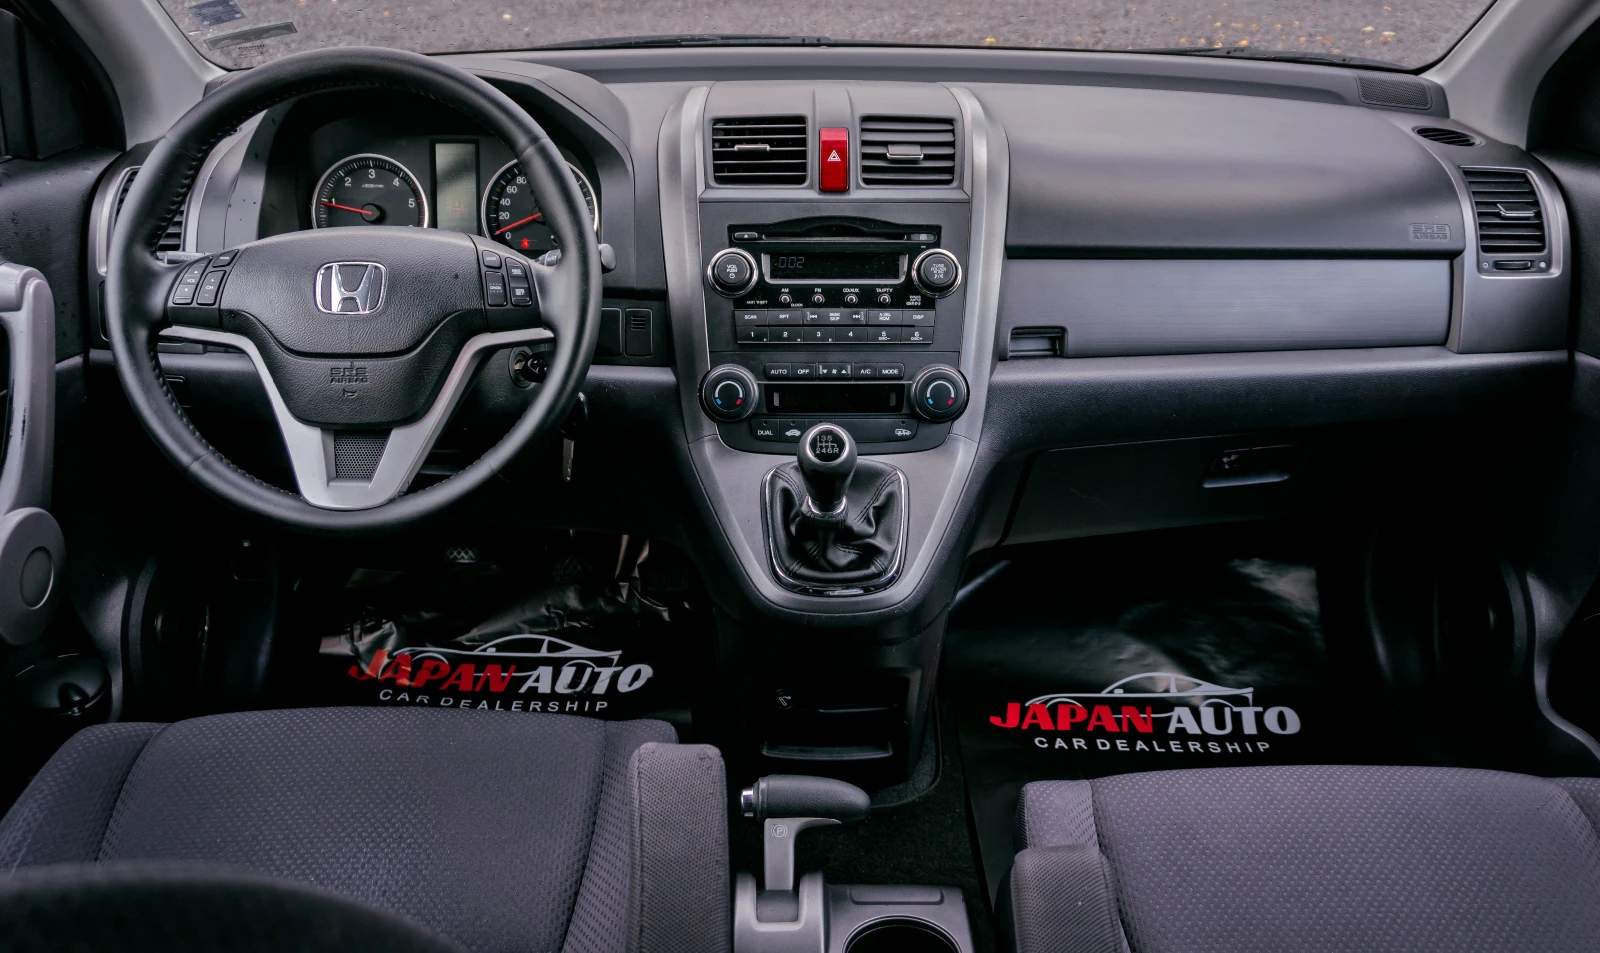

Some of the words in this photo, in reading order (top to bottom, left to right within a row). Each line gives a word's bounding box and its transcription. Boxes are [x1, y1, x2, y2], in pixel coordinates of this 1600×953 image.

[368, 169, 376, 179] 3
[344, 177, 352, 187] 2
[392, 177, 400, 187] 4
[516, 176, 527, 184] 80
[506, 185, 518, 194] 60
[408, 199, 415, 208] 5
[500, 198, 511, 206] 40
[499, 211, 510, 220] 20
[1412, 225, 1447, 233] SRS
[505, 231, 512, 240] 0
[348, 648, 517, 692] JAPAN
[518, 664, 654, 694] AUTO
[379, 689, 430, 704] CAR
[440, 697, 608, 712] DEALERSHIP
[990, 702, 1153, 733] JAPAN
[1167, 706, 1301, 735] AUTO
[1034, 736, 1089, 750] CAR
[1097, 739, 1271, 753] DEALERSHIP
